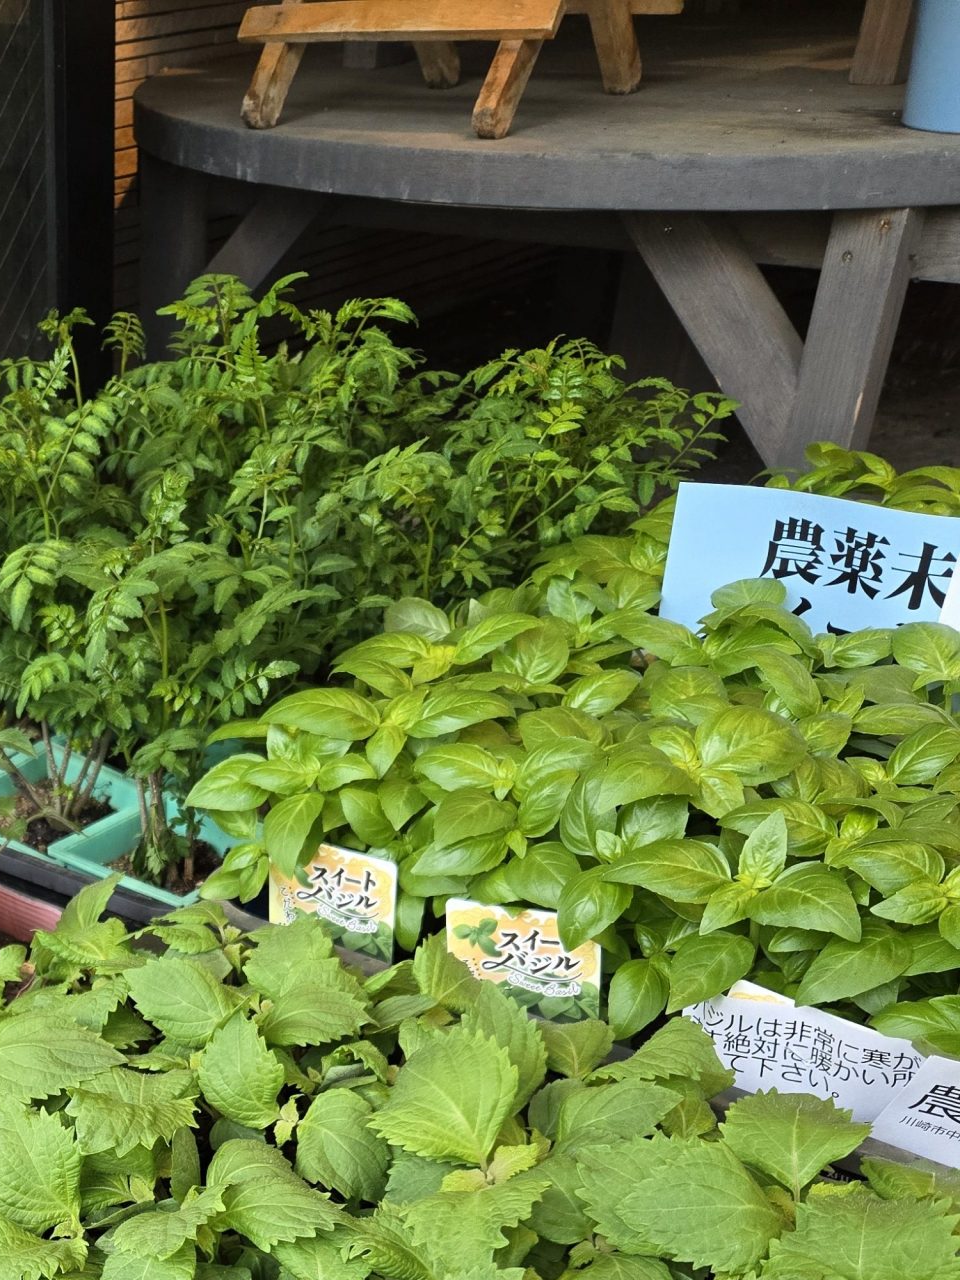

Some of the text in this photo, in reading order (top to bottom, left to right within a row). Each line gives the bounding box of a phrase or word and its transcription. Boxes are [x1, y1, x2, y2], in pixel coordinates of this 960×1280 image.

[760, 517, 957, 610] 農薬未
[311, 864, 378, 893] スイート
[296, 886, 379, 913] バジル
[499, 928, 562, 954] スイー
[482, 949, 582, 976] バジル
[692, 1015, 917, 1088] 絶対に暖かい所
[724, 1052, 840, 1099] て下さい。
[898, 1115, 960, 1142] 川崎市中
